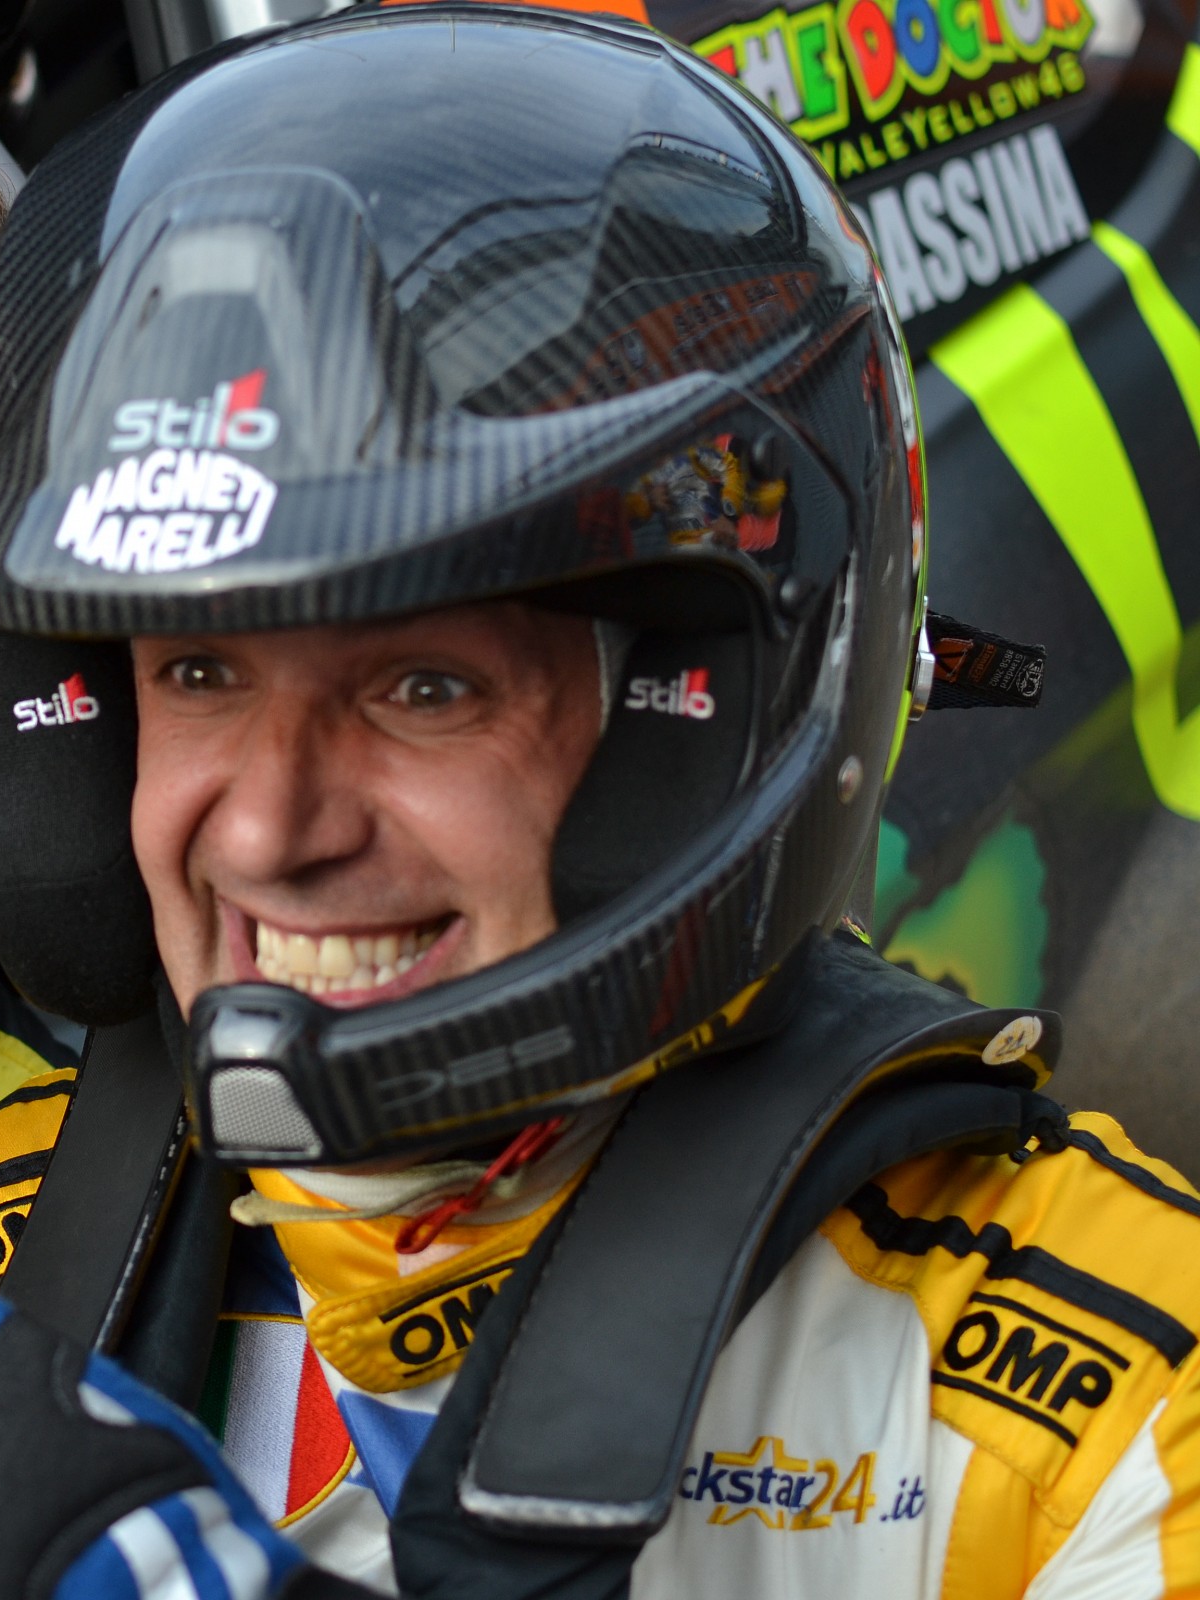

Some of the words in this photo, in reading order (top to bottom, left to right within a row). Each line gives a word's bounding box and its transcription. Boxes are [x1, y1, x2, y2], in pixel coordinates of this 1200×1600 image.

[703, 18, 842, 130] HE
[852, 122, 1092, 322] ASSINA
[108, 372, 279, 450] Stilo
[54, 448, 278, 545] MAGNETI
[54, 498, 277, 573] MARELLI
[13, 676, 99, 731] Stilo
[624, 669, 715, 720] Stilo
[942, 1310, 1113, 1414] OMP
